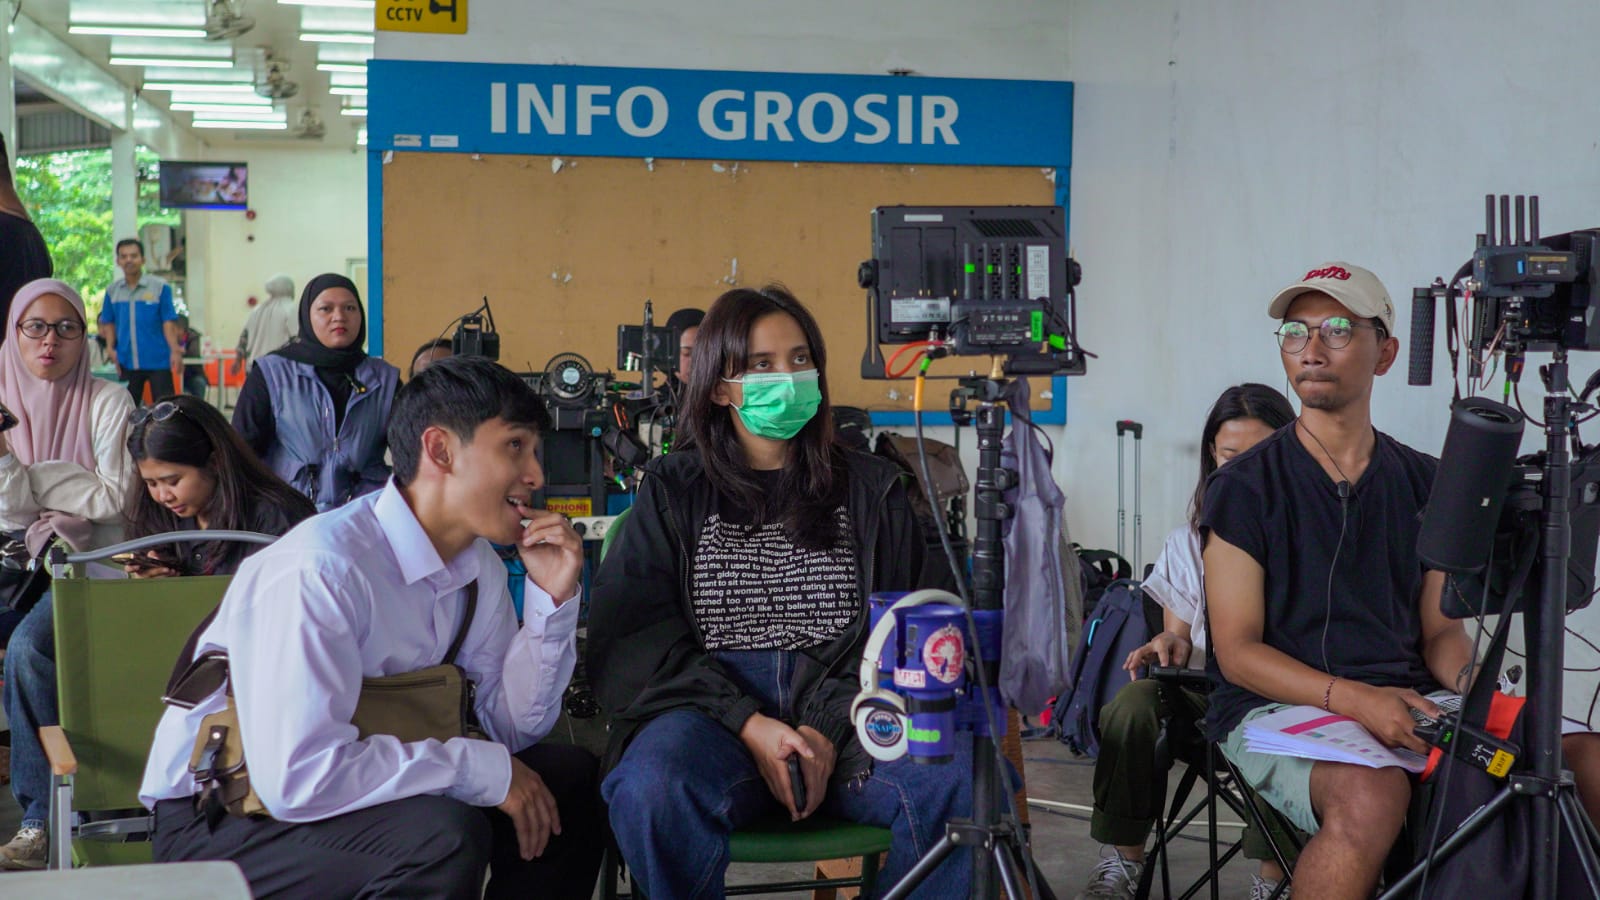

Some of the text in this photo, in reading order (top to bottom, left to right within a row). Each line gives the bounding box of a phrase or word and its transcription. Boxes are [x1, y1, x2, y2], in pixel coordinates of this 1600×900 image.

[386, 7, 423, 21] CCTV
[491, 82, 960, 145] INFO GROSIR
[762, 522, 784, 530] angry
[804, 556, 834, 564] friends,
[717, 571, 740, 579] giddy
[786, 567, 807, 576] awful
[700, 589, 724, 597] dating
[768, 586, 783, 594] you
[787, 602, 816, 610] believe
[734, 619, 757, 627] lapels
